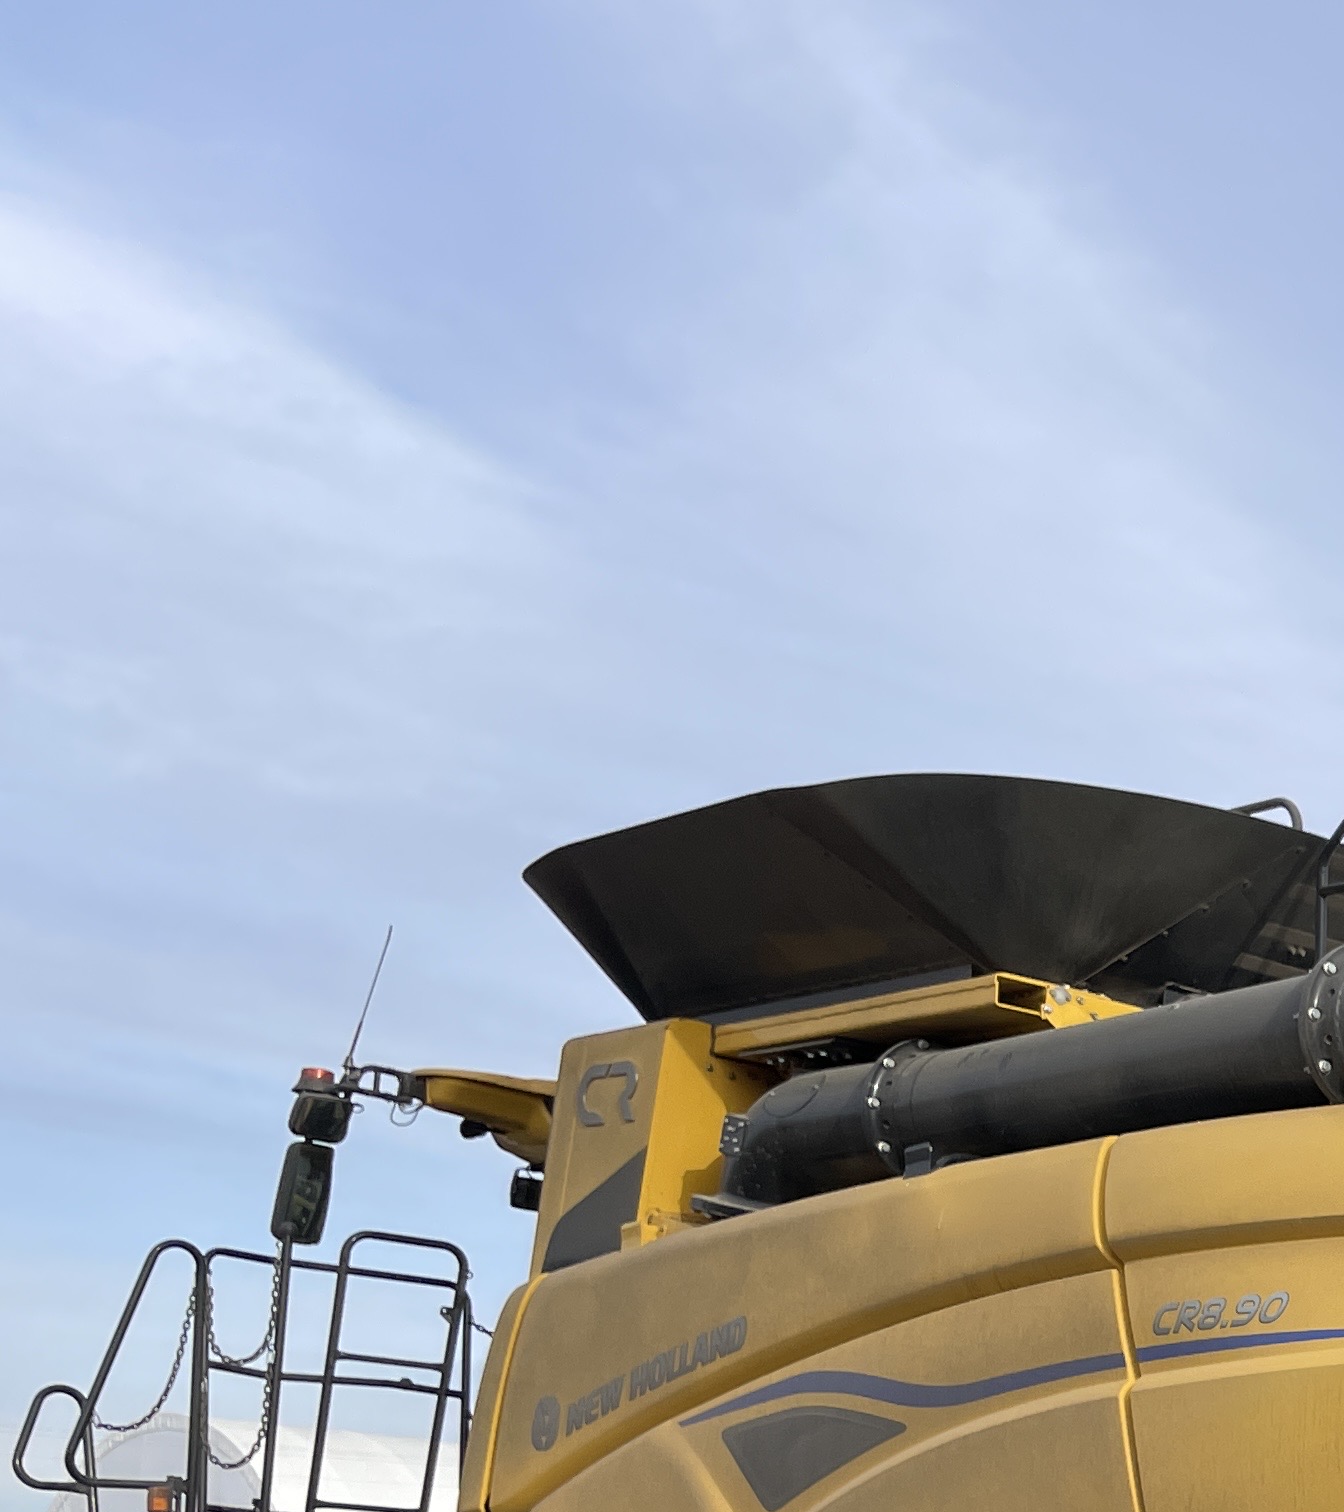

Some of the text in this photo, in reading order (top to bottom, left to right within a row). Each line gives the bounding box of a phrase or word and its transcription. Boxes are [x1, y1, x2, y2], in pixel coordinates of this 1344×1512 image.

[576, 1060, 639, 1128] CR
[1152, 1291, 1290, 1336] CR8.90
[565, 1315, 748, 1437] NEW HOLLAND
